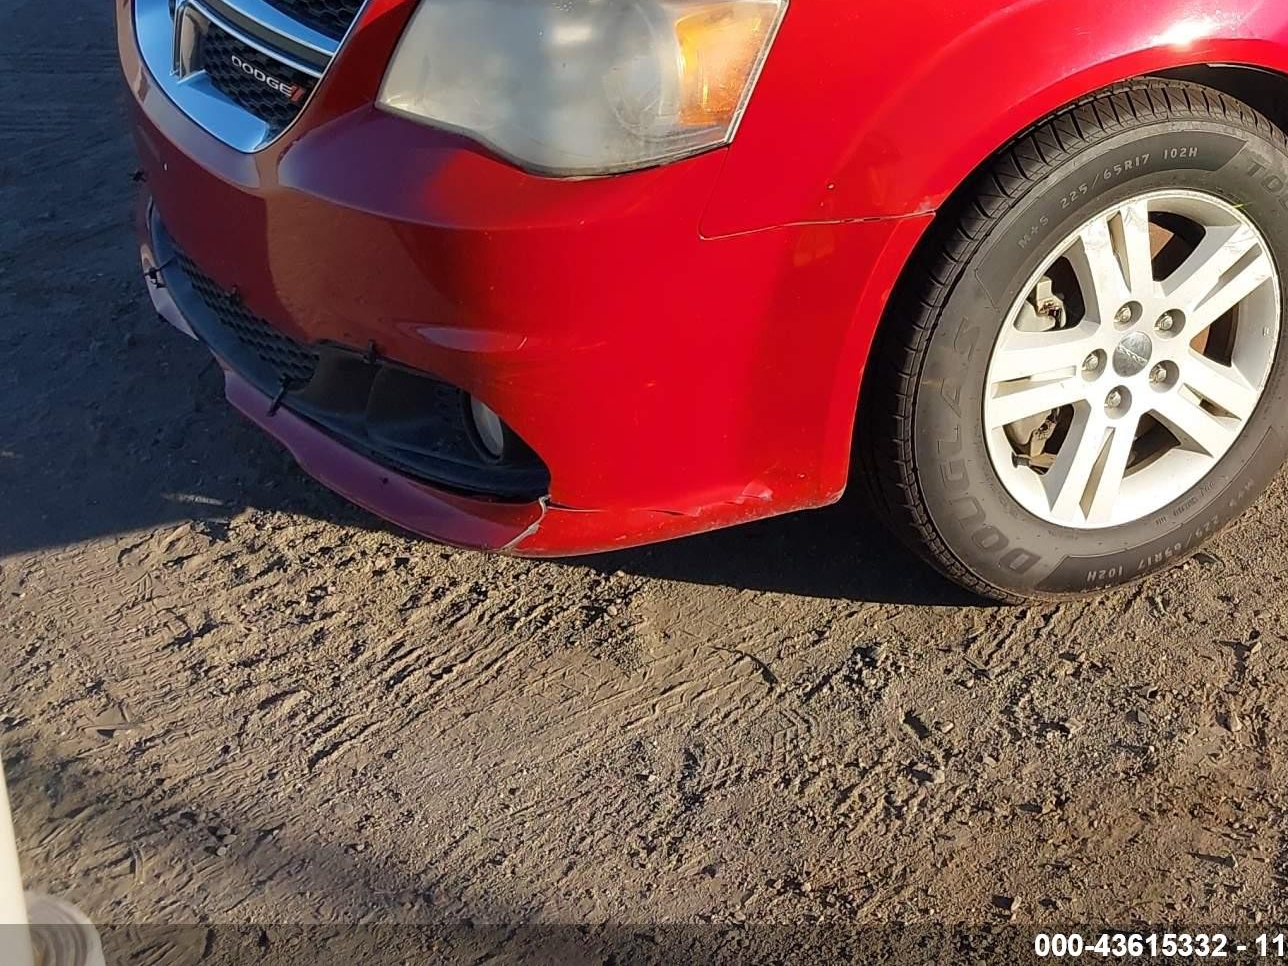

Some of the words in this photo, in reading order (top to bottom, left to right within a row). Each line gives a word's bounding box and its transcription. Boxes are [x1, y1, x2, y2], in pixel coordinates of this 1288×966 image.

[231, 55, 293, 97] DODGE
[1060, 153, 1150, 209] 225/65R17
[1162, 146, 1199, 160] 102H
[937, 316, 1043, 576] DOUGLAS
[1087, 565, 1124, 583] 102H
